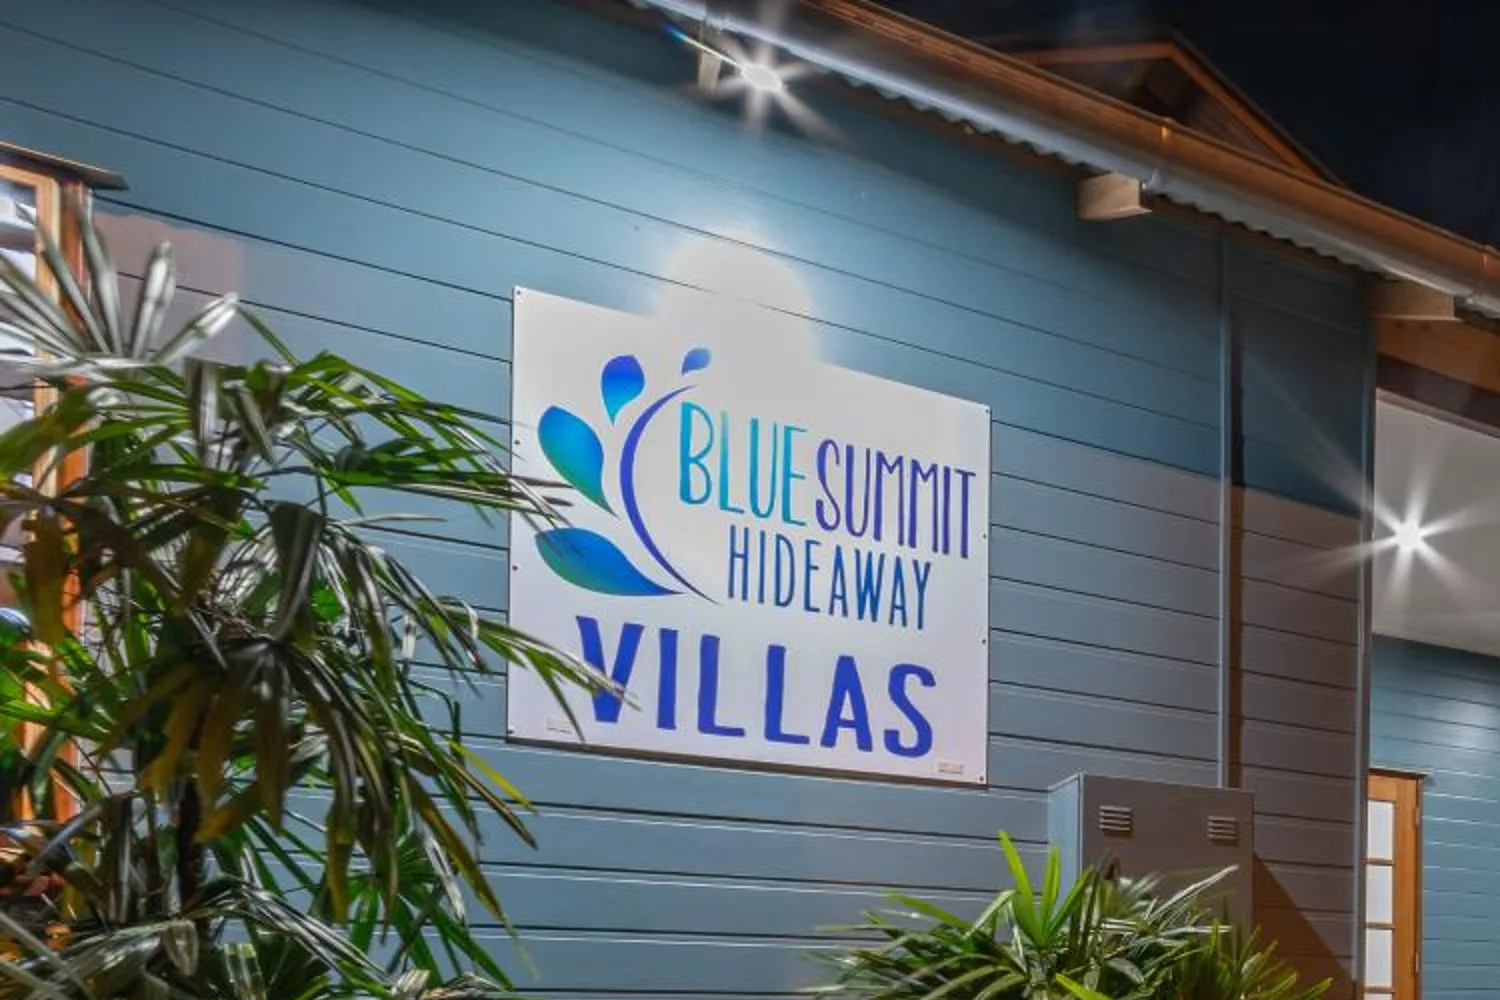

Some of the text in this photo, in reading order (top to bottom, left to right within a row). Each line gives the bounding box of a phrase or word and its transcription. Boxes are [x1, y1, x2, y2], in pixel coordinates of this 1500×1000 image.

[679, 401, 976, 559] BLUE SUMMIT
[728, 525, 932, 630] HIDEAWAY
[576, 615, 937, 758] VILLAS
